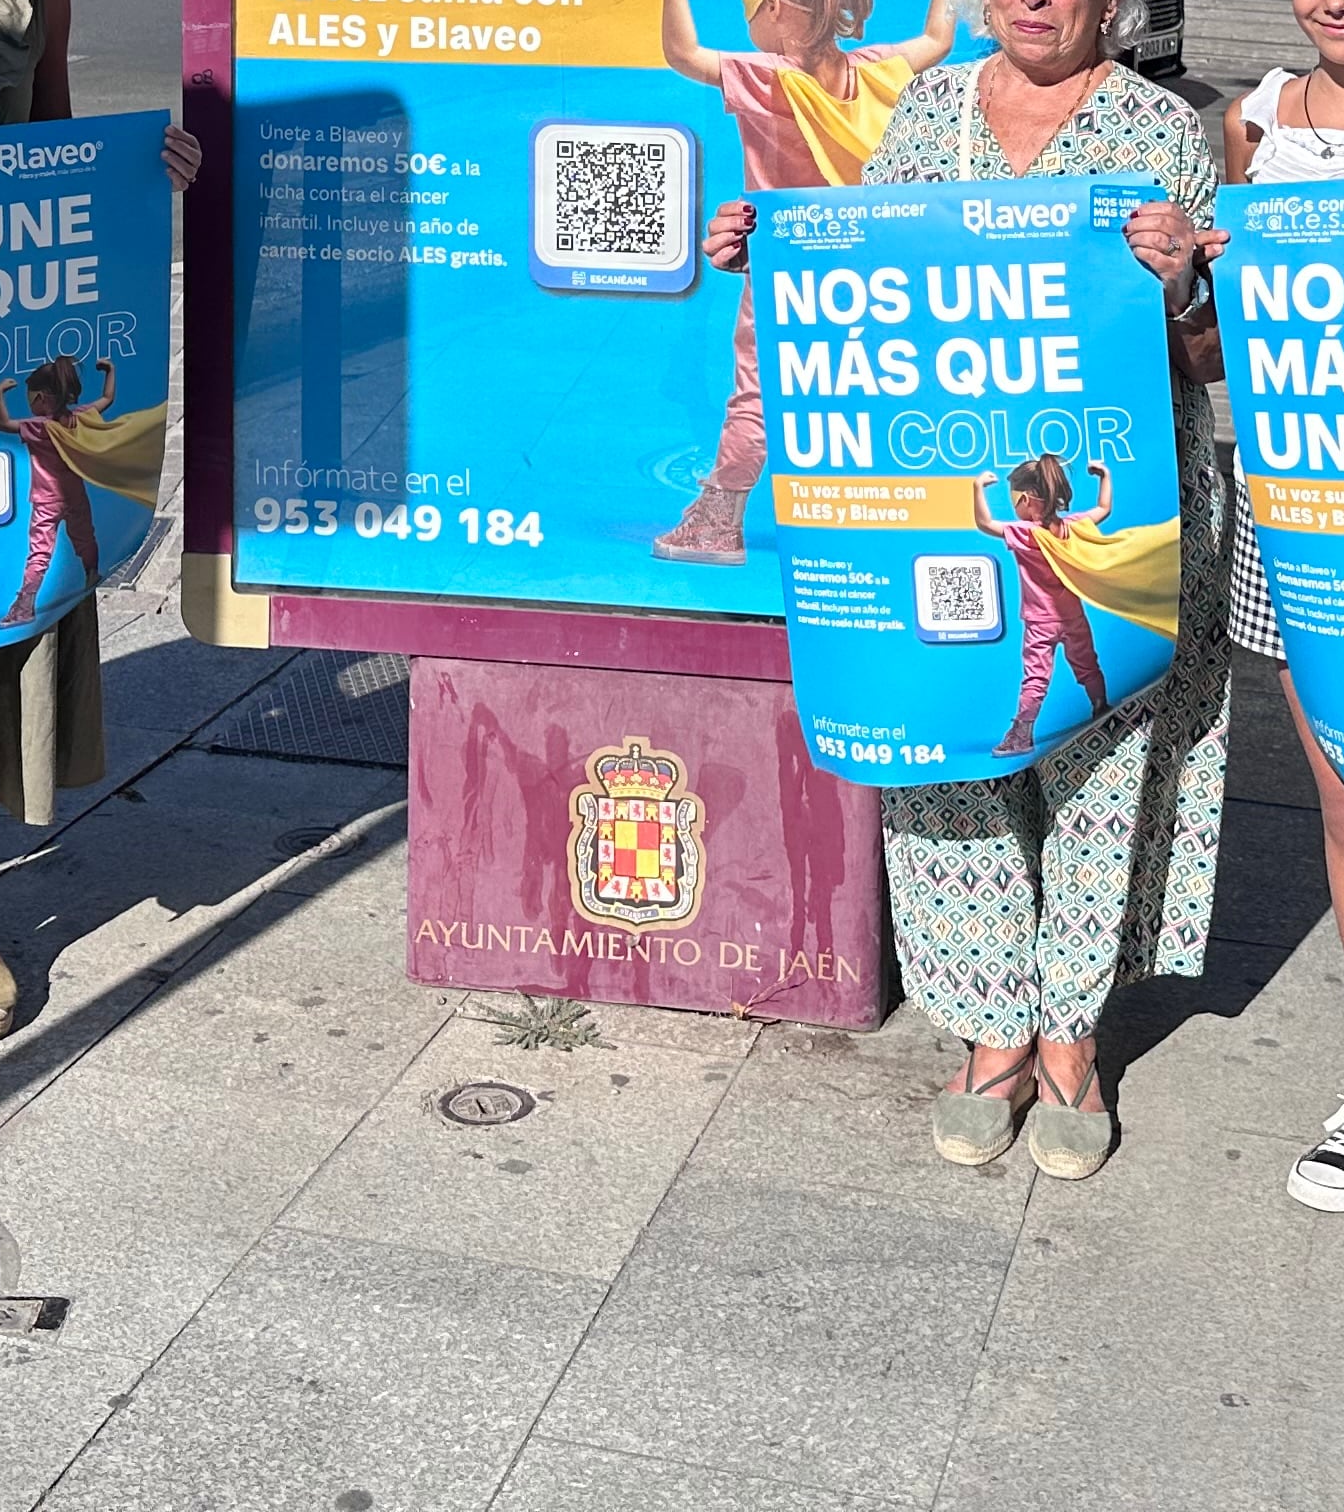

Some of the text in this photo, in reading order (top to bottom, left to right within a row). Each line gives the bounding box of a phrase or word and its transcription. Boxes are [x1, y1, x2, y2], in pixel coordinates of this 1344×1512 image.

[269, 14, 541, 56] ALES y Blaveo
[260, 120, 402, 147] Únete a Blaveo y
[260, 150, 480, 176] donaremos 50€ a la
[260, 184, 449, 204] lucha contra el cáncer
[1094, 198, 1117, 206] NOS
[260, 214, 479, 236] infantil. Incluye un año de
[1094, 207, 1117, 217] MÁS
[1094, 218, 1109, 227] UN
[259, 245, 508, 268] carnet de socio ALES gratis.
[590, 272, 649, 287] ESCANÉAME
[774, 263, 1070, 324] NOS UNE
[779, 327, 1083, 398] MÁS QUE
[783, 406, 1135, 469] UN COLOR
[254, 458, 472, 497] Infórmate en el
[254, 496, 545, 547] 953 049 184
[816, 735, 945, 764] 953 049 184
[415, 918, 862, 983] AYUNTAMIENTO DE JAÉN
